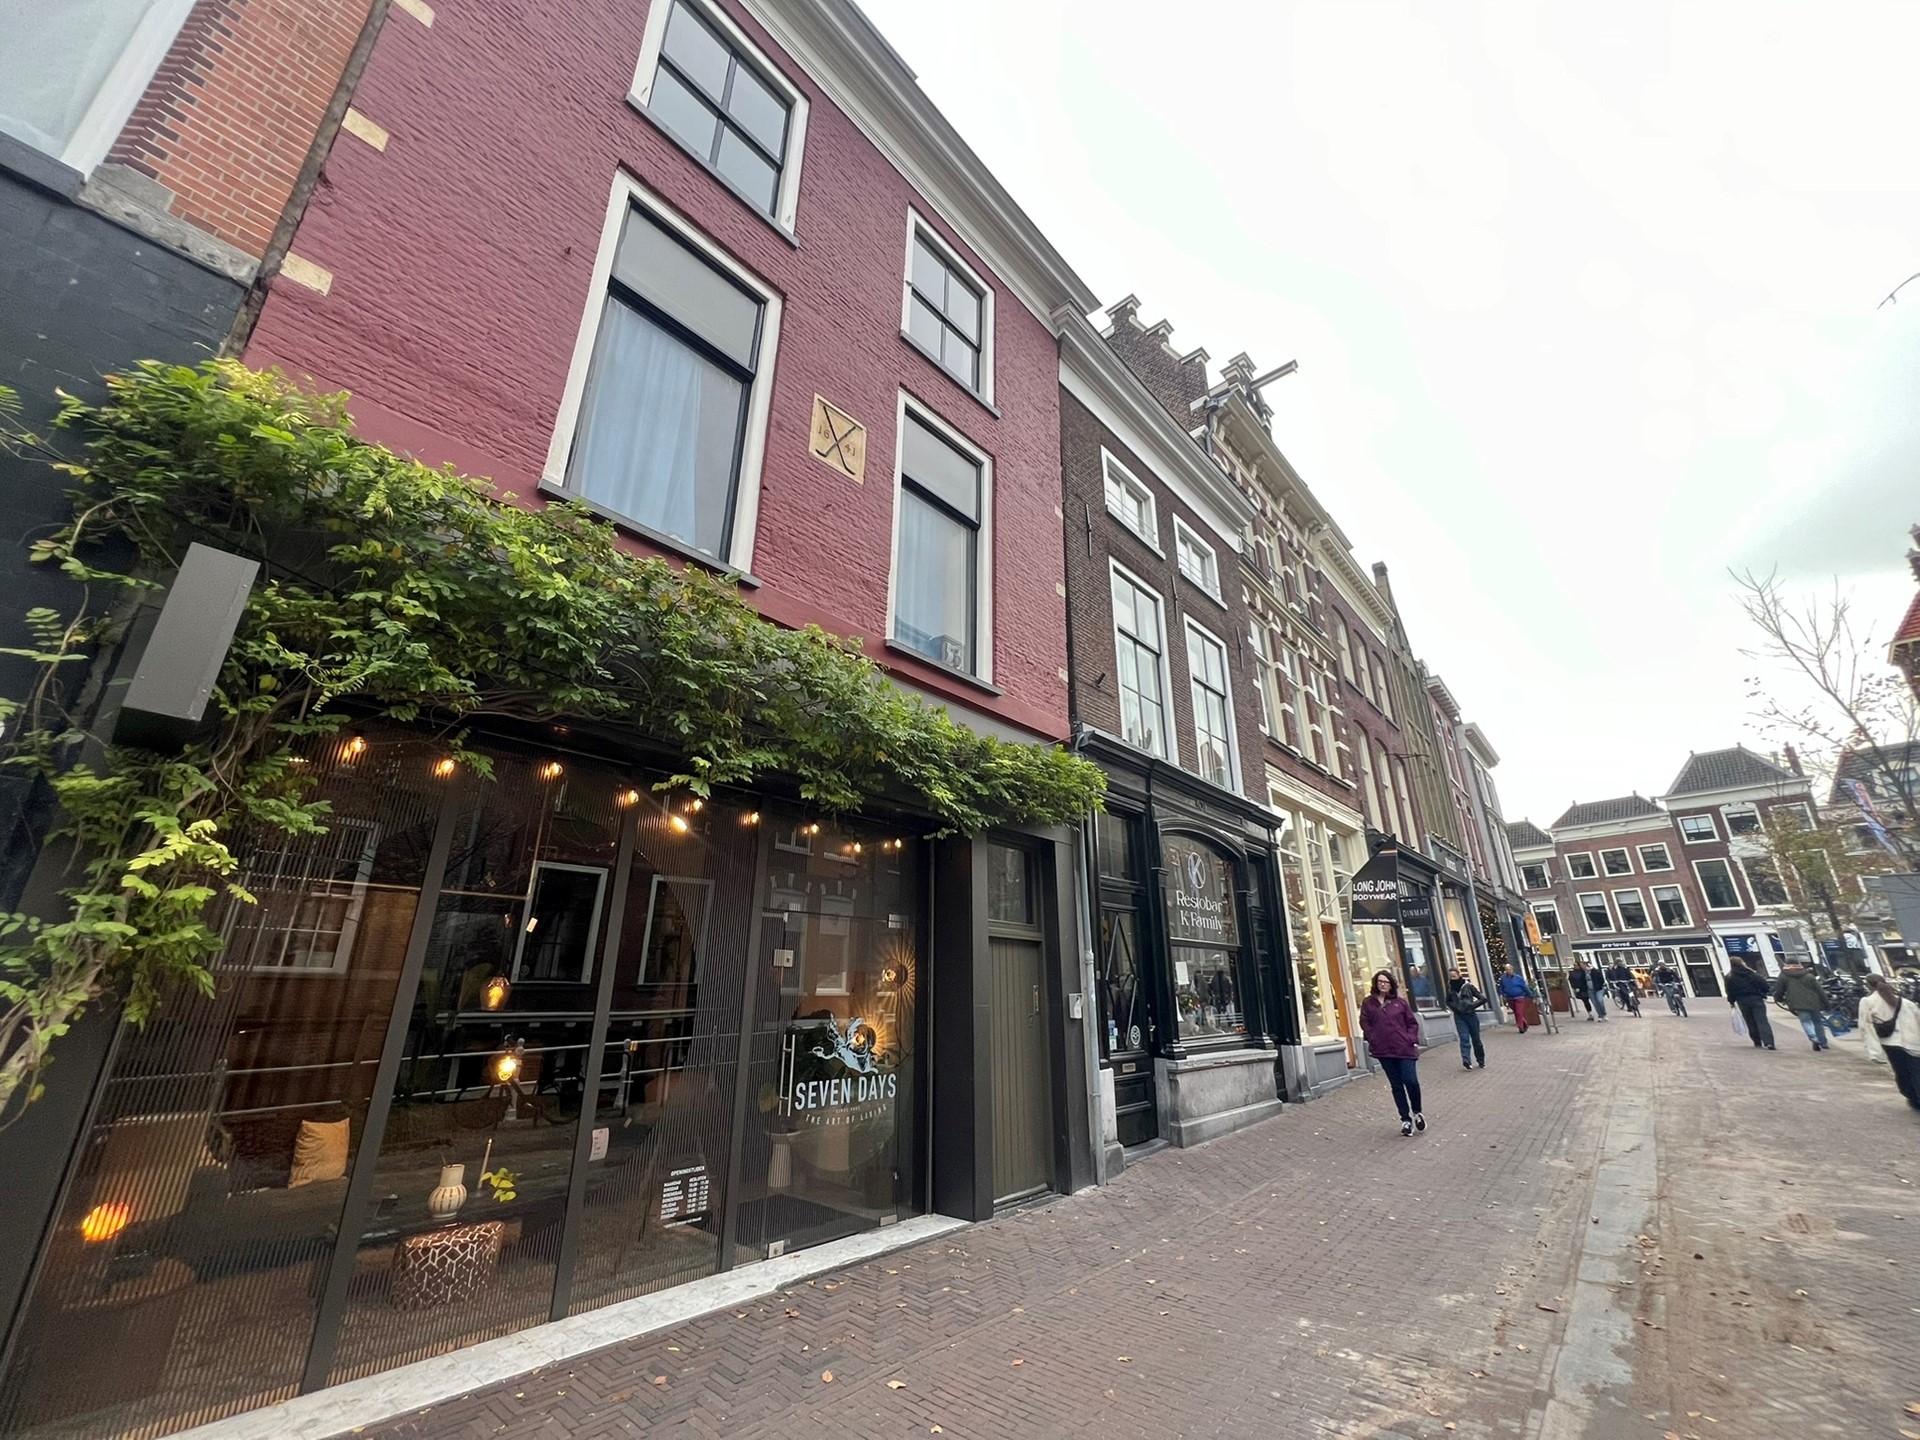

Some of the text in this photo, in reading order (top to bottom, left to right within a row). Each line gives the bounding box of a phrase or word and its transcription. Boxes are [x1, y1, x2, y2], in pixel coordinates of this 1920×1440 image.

[1352, 893, 1397, 901] BODYWEAR
[1353, 880, 1397, 892] LONG JOHN
[1176, 890, 1223, 912] Restobar
[1180, 910, 1222, 935] K Family
[795, 1073, 897, 1110] SEVEN DAYS
[805, 1114, 821, 1125] THE
[826, 1117, 841, 1126] ART
[846, 1115, 855, 1125] OF
[860, 1103, 887, 1121] LIVING
